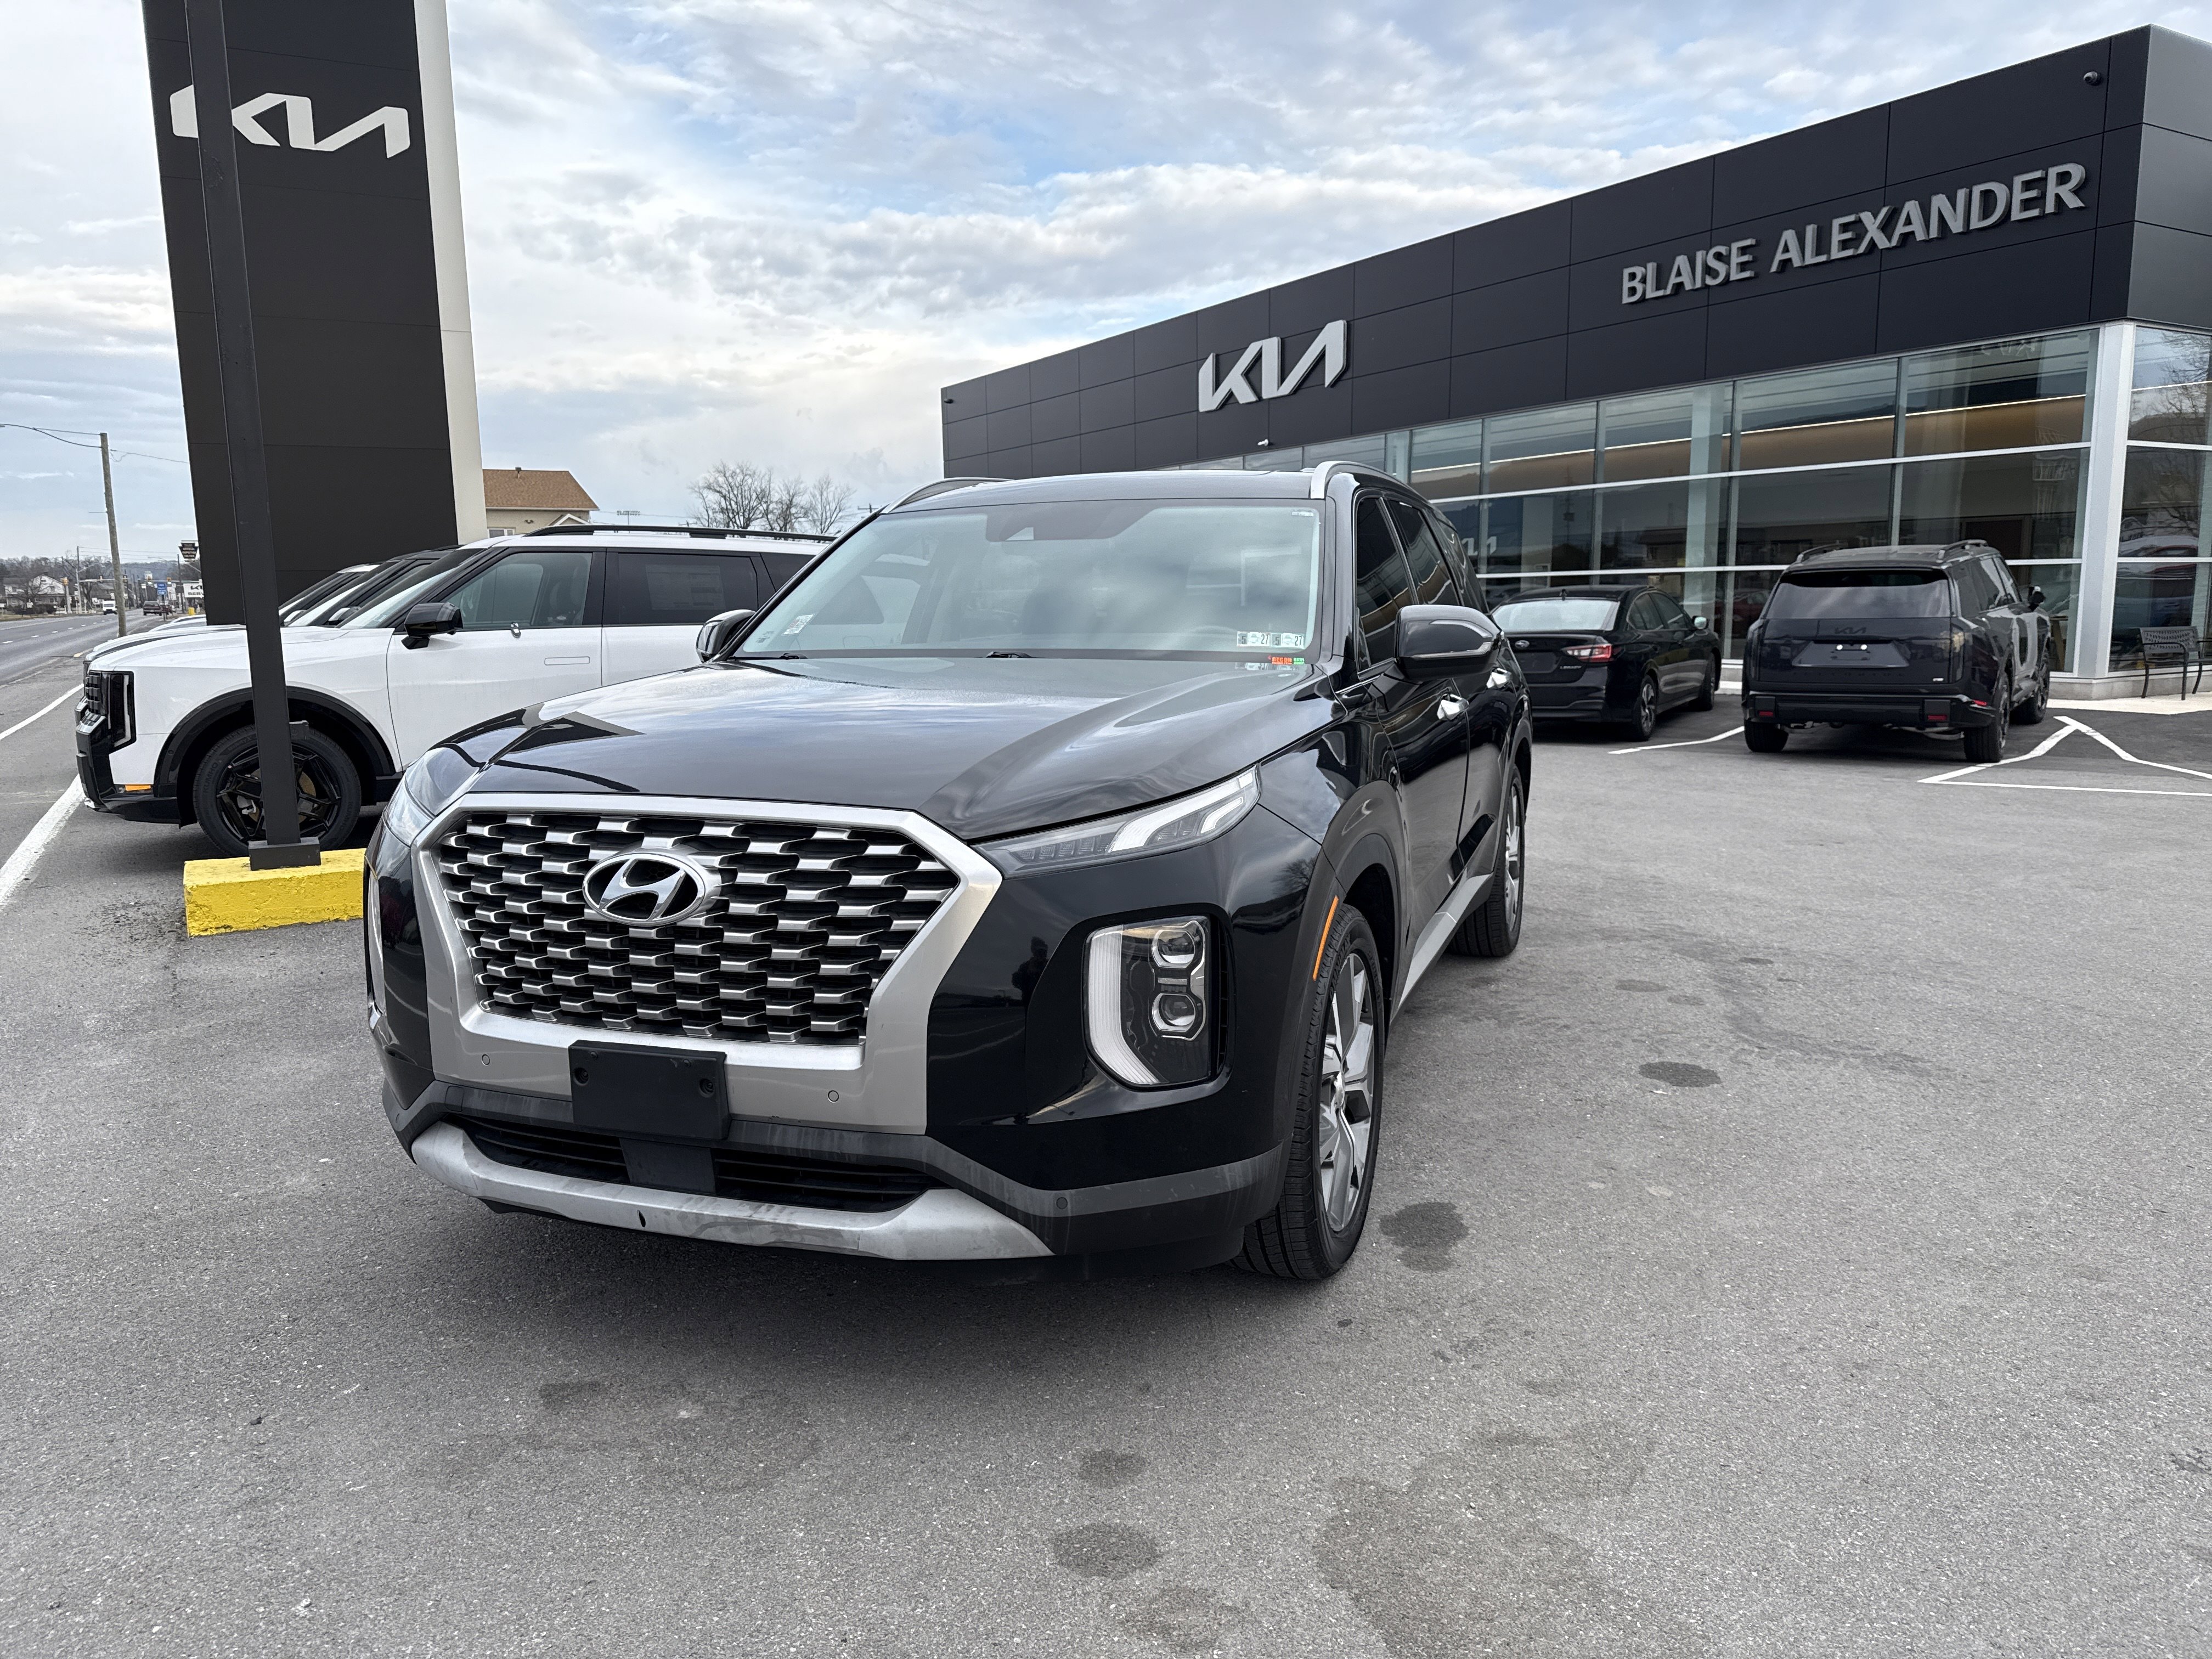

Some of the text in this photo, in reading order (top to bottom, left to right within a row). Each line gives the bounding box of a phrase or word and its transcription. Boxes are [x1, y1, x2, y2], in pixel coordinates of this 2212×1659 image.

[1621, 162, 2086, 304] BLAISE ALEXANDER
[1198, 319, 1347, 412] KIA
[1261, 634, 1268, 645] 27
[1295, 635, 1302, 646] 27
